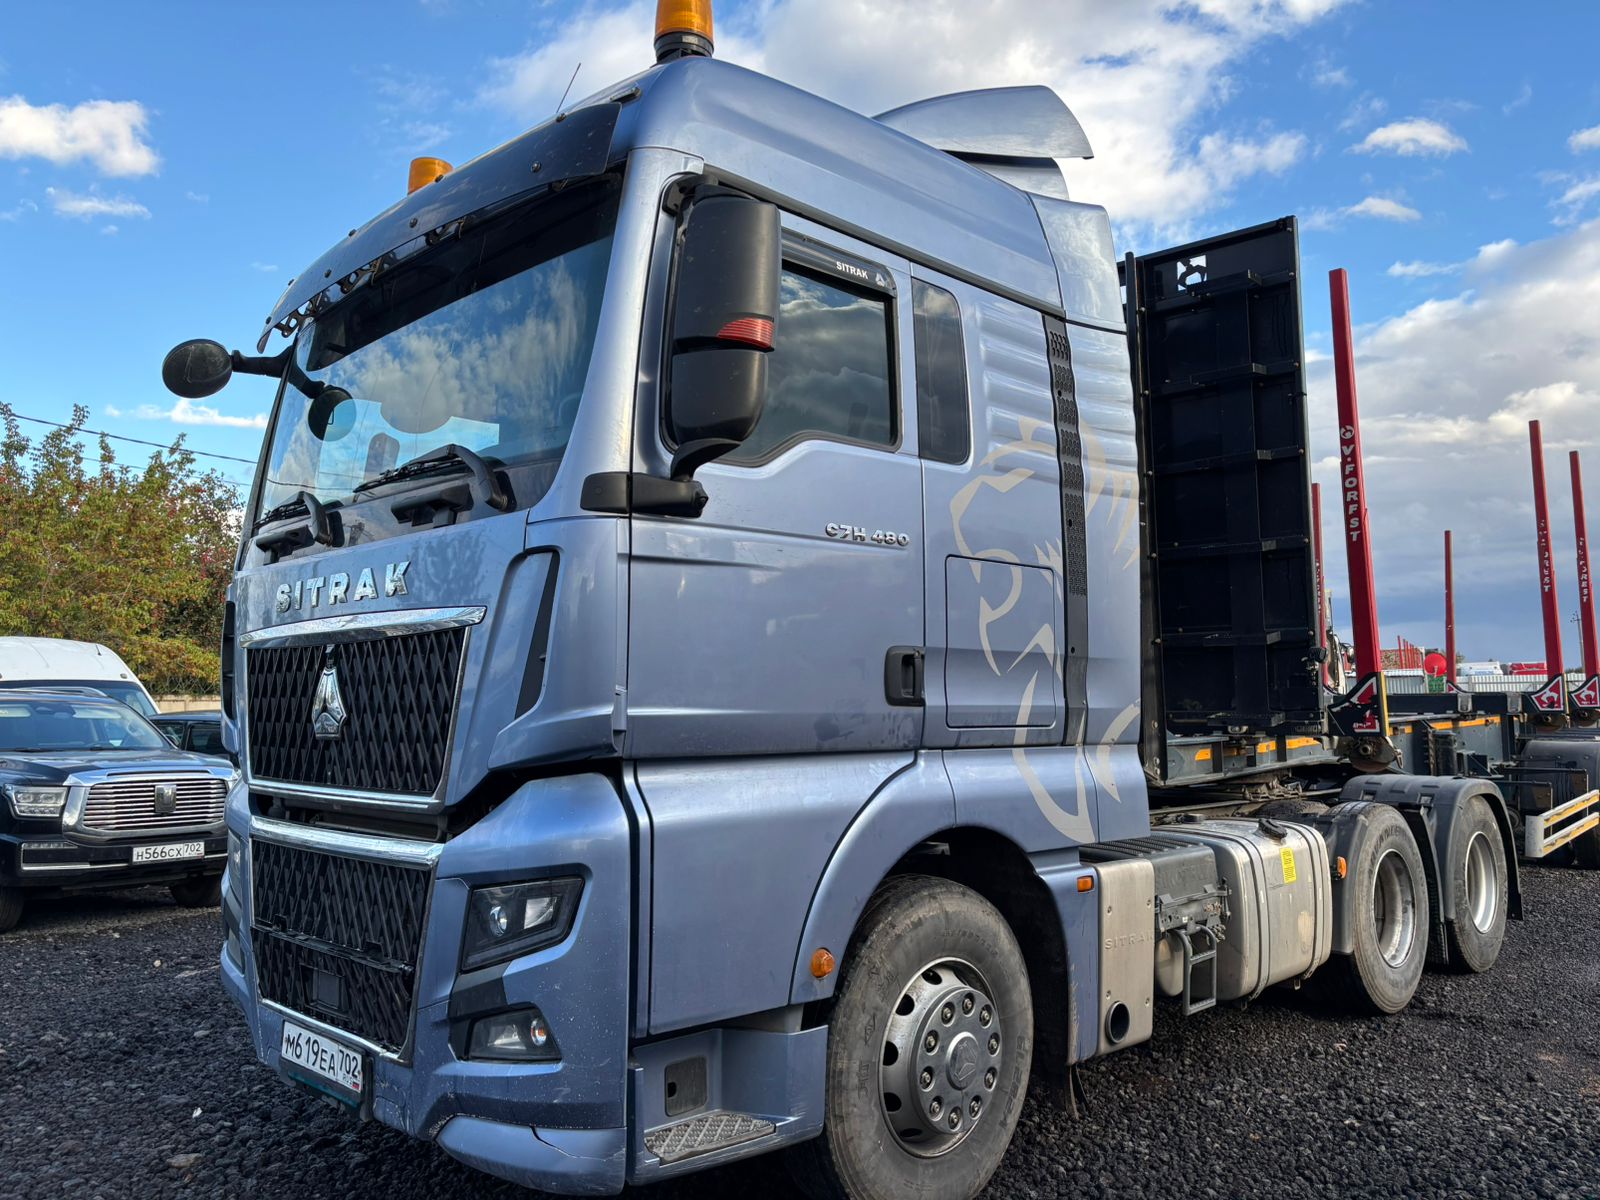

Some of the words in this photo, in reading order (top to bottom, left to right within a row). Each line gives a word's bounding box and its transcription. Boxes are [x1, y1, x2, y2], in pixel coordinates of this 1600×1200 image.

[836, 261, 868, 280] SITRAK
[825, 522, 866, 542] C7H
[871, 529, 910, 547] 480
[276, 560, 411, 613] SITRAK
[185, 843, 201, 853] 702
[285, 1032, 336, 1077] М619ЕА
[339, 1049, 359, 1079] 702
